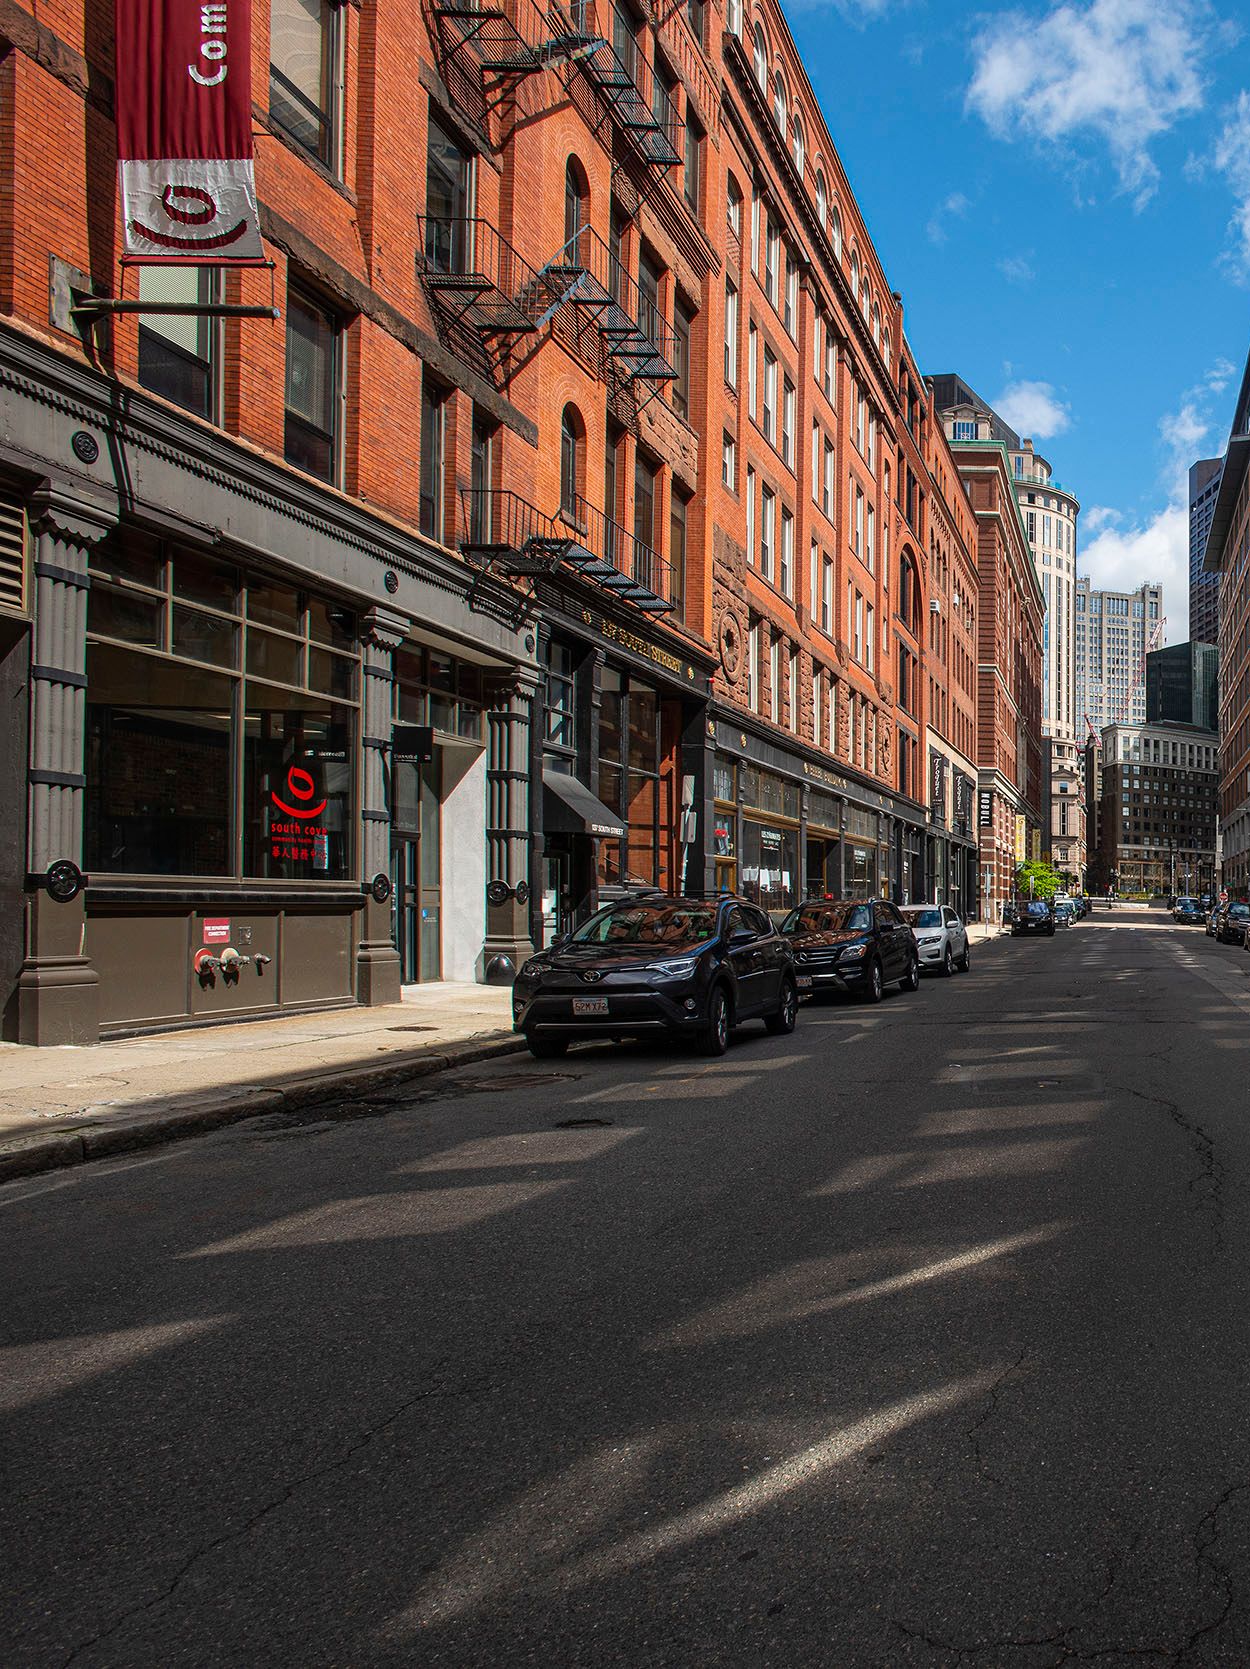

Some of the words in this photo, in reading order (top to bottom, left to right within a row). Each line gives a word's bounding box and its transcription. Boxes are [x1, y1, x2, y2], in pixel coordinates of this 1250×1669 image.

[188, 4, 227, 86] Com
[650, 645, 683, 674] STREET
[981, 792, 990, 826] NOBULL
[271, 822, 301, 834] south
[305, 826, 328, 836] cove
[611, 827, 624, 836] STREET
